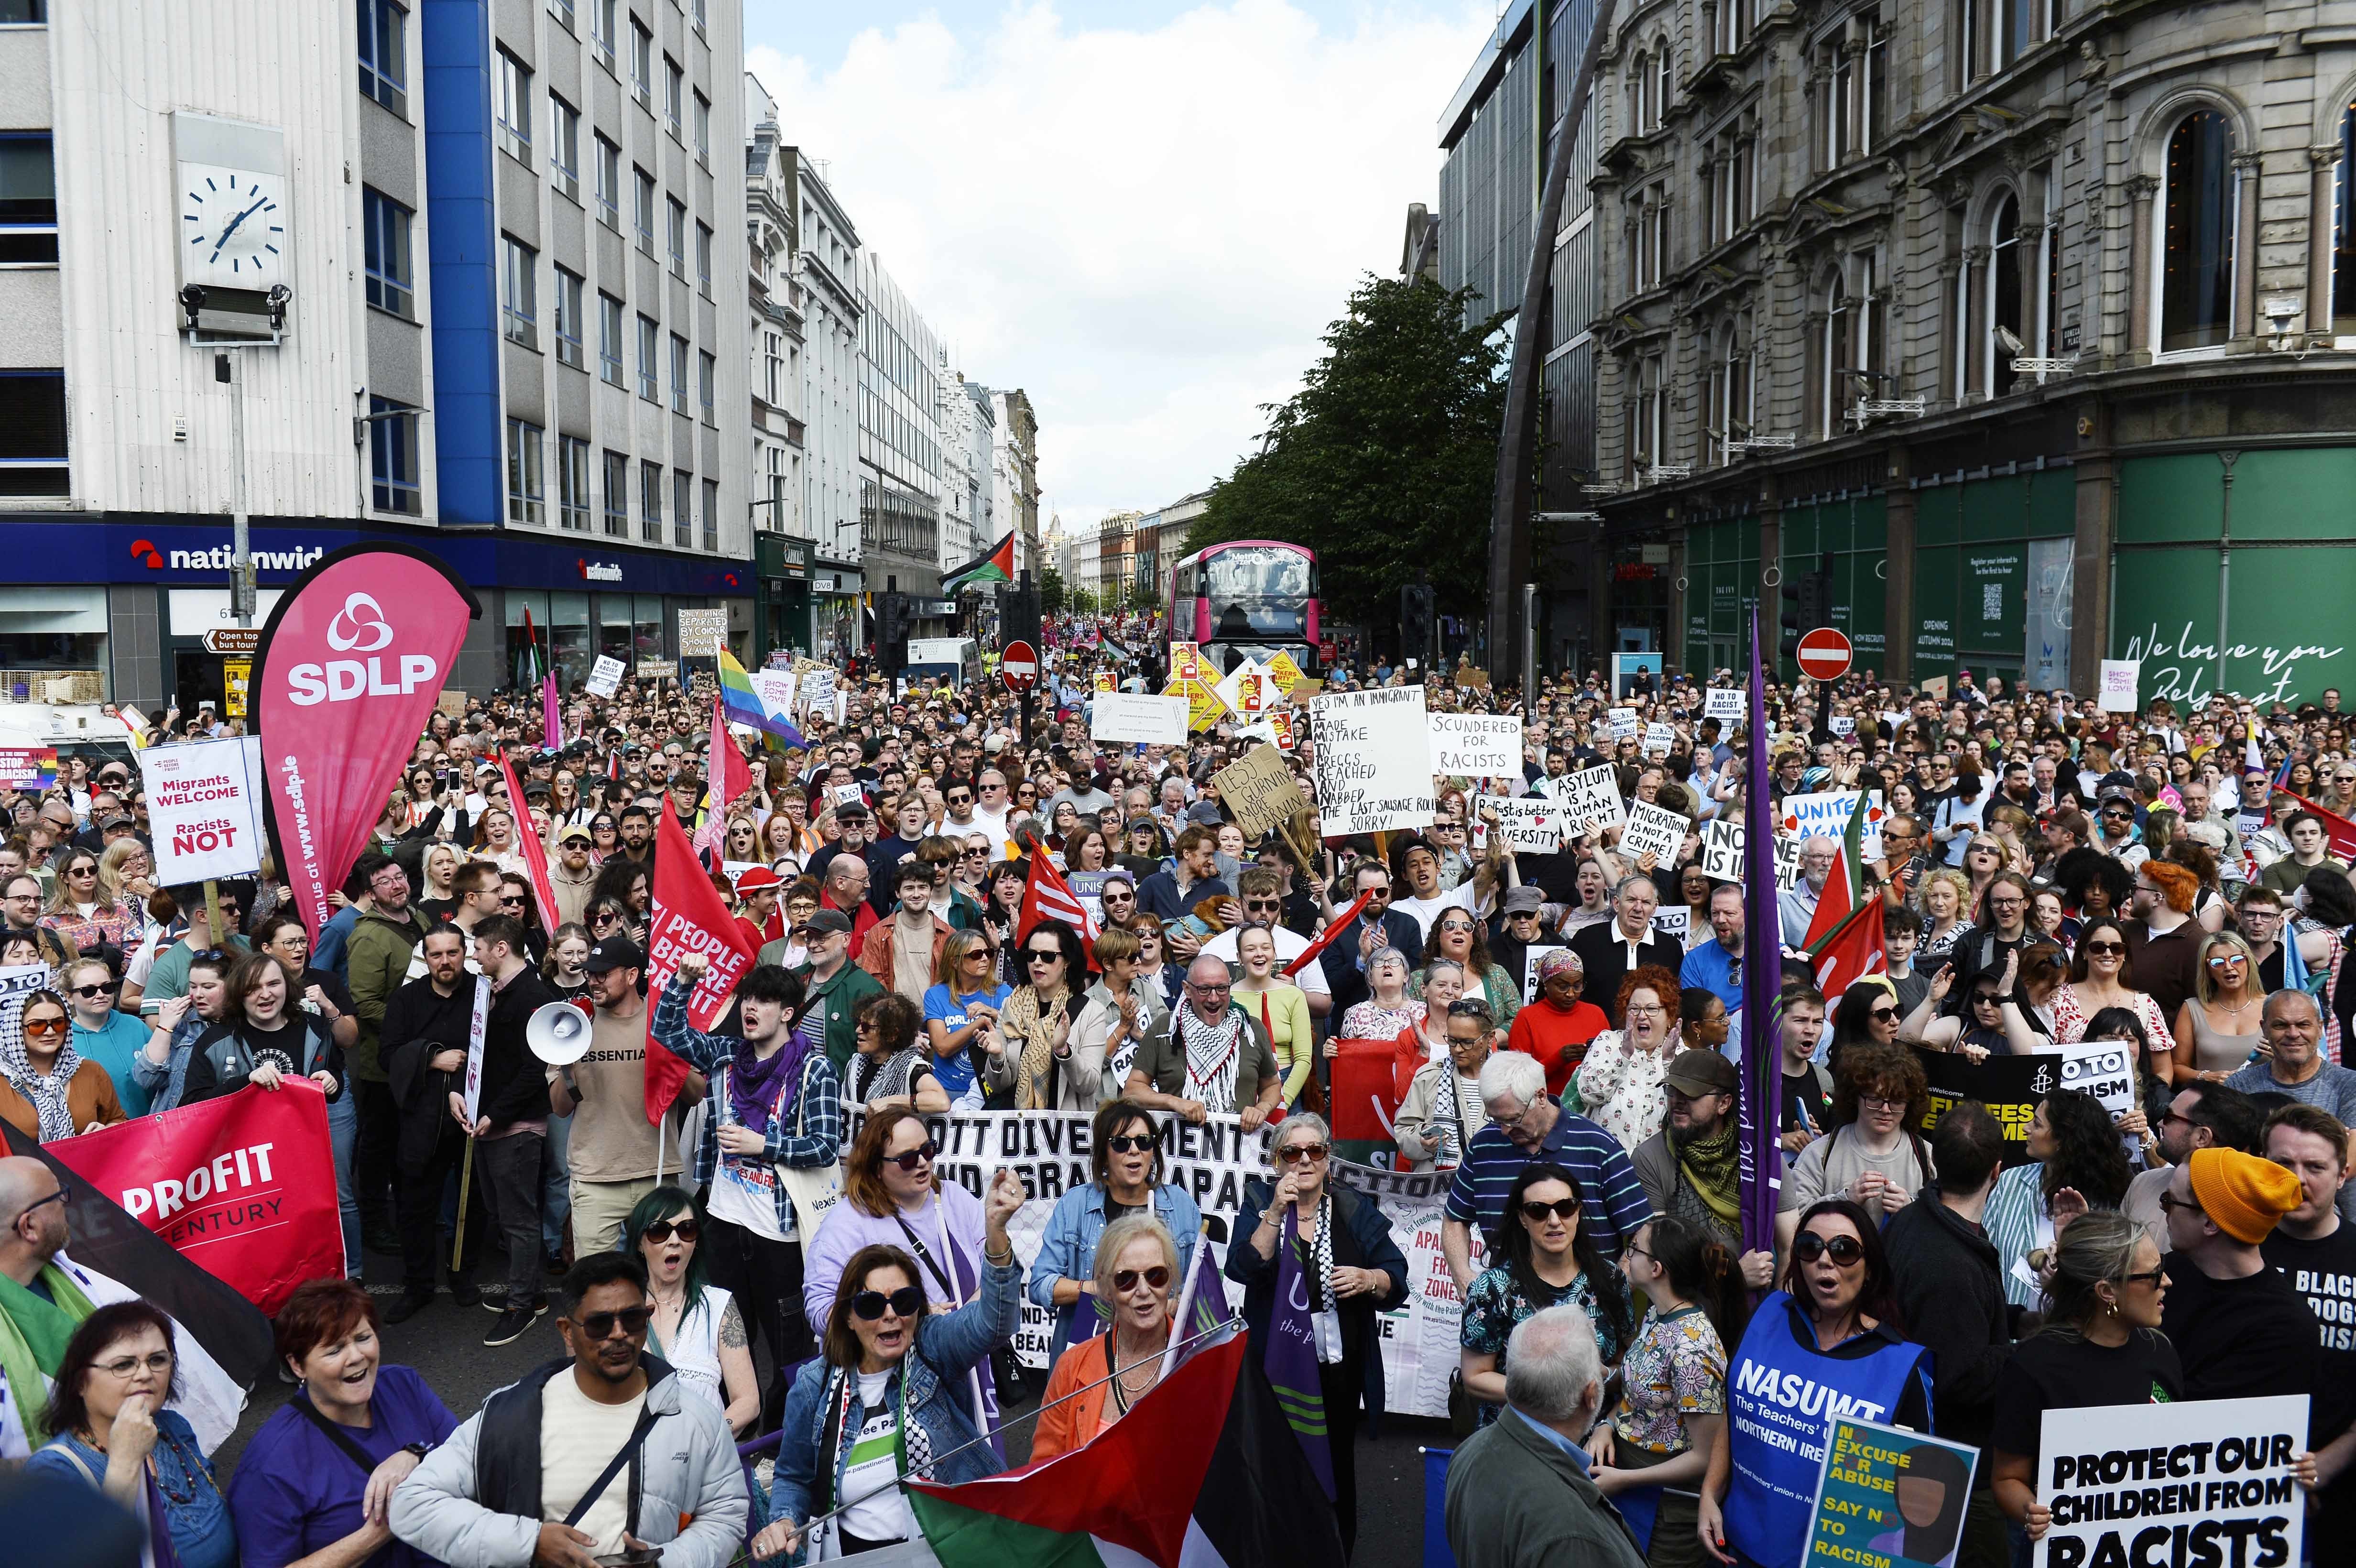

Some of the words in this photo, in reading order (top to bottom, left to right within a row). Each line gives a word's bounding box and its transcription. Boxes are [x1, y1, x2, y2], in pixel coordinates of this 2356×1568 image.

[171, 545, 323, 570] natinwid
[679, 610, 700, 618] ONLY
[700, 609, 724, 618] THING
[679, 617, 727, 627] SEPARATED
[680, 627, 695, 636] BY
[1923, 621, 1948, 631] OPENING
[219, 632, 241, 641] Open
[244, 632, 258, 641] top
[1918, 635, 1941, 645] AUTUMN
[1941, 637, 1953, 646] 2024
[2126, 621, 2173, 665] We
[2178, 621, 2259, 661] love
[2262, 644, 2344, 675] you
[599, 664, 618, 674] RACIST
[288, 654, 436, 706] SDLP
[764, 680, 788, 688] SHOW
[1312, 696, 1330, 710] YES
[1333, 695, 1348, 708] I'M
[1354, 694, 1365, 707] AN
[1370, 689, 1421, 706] IMMIGRANT
[1312, 710, 1325, 721] I
[1432, 716, 1518, 733] SCUNDERED
[1313, 719, 1348, 732] MADE
[1314, 727, 1368, 744] MISTAKE
[1463, 735, 1489, 747] FOR
[1314, 742, 1331, 757] IN
[0, 757, 24, 769] STOP
[1317, 753, 1360, 768] GREGGS
[1440, 751, 1506, 769] RACISTS
[0, 769, 37, 780] RACISM
[1218, 757, 1257, 795] LESS
[1317, 764, 1376, 782] REACHED
[1558, 767, 1612, 796] ASYLUM
[163, 774, 230, 793] Migrants
[1240, 768, 1289, 803] GURNIN
[1320, 779, 1345, 795] AND
[156, 786, 239, 807] WELCOME
[845, 788, 858, 799] TO
[1320, 788, 1364, 806] NABBED
[1568, 793, 1578, 805] IS
[1586, 790, 1596, 801] A
[284, 754, 316, 861] www.sdlp.ie
[1236, 798, 1270, 824] MORE
[1247, 795, 1303, 838] LEARNIN
[1320, 805, 1342, 820] THE
[1350, 802, 1375, 816] LAST
[1376, 797, 1413, 813] SAUSAGE
[1416, 797, 1437, 812] ROLL
[1515, 807, 1523, 817] is
[1524, 804, 1556, 816] better
[1562, 796, 1612, 818] HUMAN
[1791, 797, 1871, 820] UNITED
[176, 817, 230, 835] Racists
[1349, 814, 1394, 832] SORRY!
[1633, 803, 1688, 835] MIGRATION
[2241, 824, 2258, 832] NO
[1631, 821, 1641, 832] IS
[1643, 826, 1663, 838] NOT
[1664, 833, 1672, 843] A
[1711, 821, 1745, 850] NO
[1797, 821, 1877, 840] AGAIST
[173, 826, 237, 856] NOT
[1626, 835, 1673, 859] CRIME!
[307, 862, 319, 878] at
[1705, 849, 1725, 872] IS
[313, 881, 324, 899] us
[1661, 914, 1685, 928] TO
[666, 913, 746, 972] PEOPLE
[651, 938, 732, 994] BERE
[13, 973, 42, 990] TO
[2082, 1053, 2123, 1075] TO
[840, 1105, 991, 1157] BOOTT
[1001, 1116, 1243, 1164] DIVEMENT
[122, 1141, 273, 1220] PROFIT
[750, 1171, 763, 1184] AND
[811, 1195, 837, 1212] Nexis
[1404, 1222, 1415, 1236] For
[1415, 1212, 1442, 1228] freedom,
[1422, 1299, 1434, 1311] with
[1435, 1304, 1444, 1314] the
[1279, 1318, 1301, 1337] the
[1735, 1358, 1886, 1423] NASUWT
[1734, 1394, 1755, 1413] The
[1757, 1402, 1821, 1436] Teachers'
[1735, 1415, 1797, 1455] NORTHERN
[1837, 1438, 1911, 1469] EXCUSE
[2052, 1441, 2213, 1490] PROTECT
[2215, 1434, 2295, 1474] OUR
[1752, 1473, 1774, 1489] teachers'
[1774, 1485, 1794, 1499] union
[1795, 1492, 1803, 1502] in
[1829, 1468, 1896, 1494] ABUSE
[1823, 1496, 1863, 1517] SAY
[2048, 1481, 2201, 1527] CHILDREN
[2205, 1477, 2292, 1511] FROM
[1820, 1518, 1846, 1536] TO
[2047, 1516, 2290, 1568] RACISTS
[1815, 1540, 1891, 1568] RACISM
